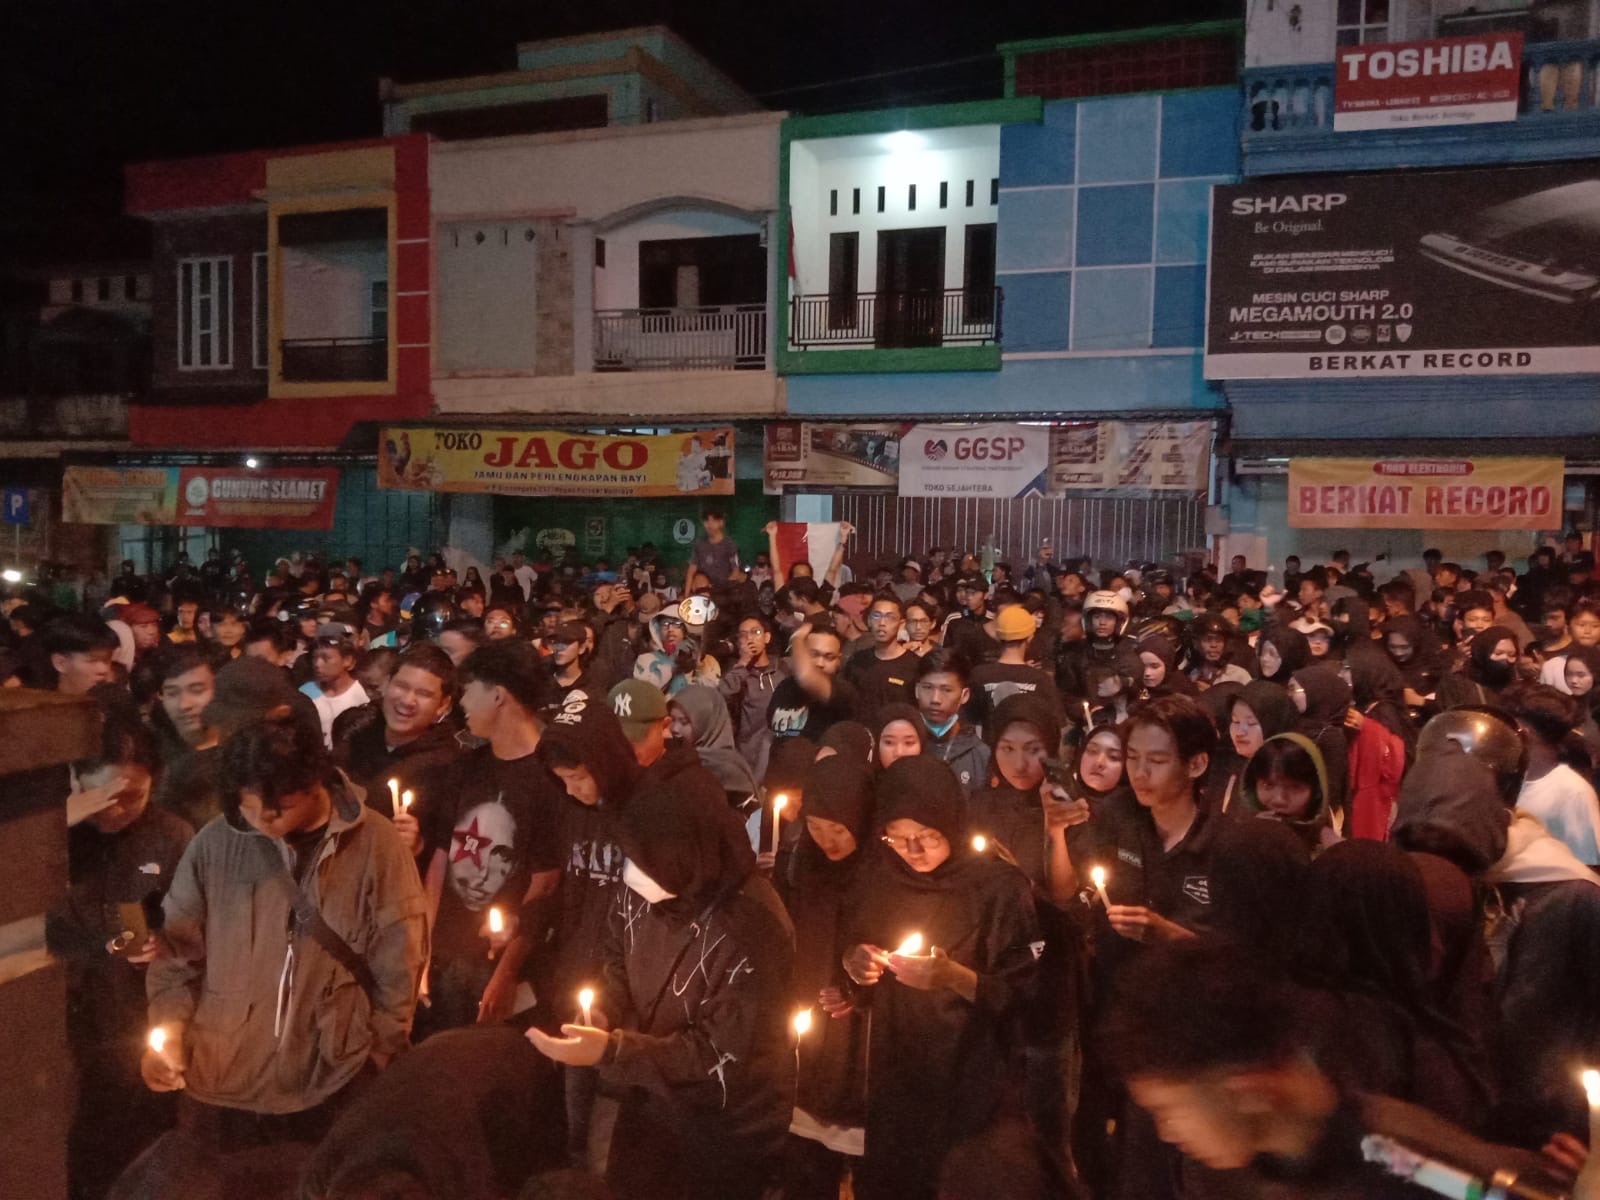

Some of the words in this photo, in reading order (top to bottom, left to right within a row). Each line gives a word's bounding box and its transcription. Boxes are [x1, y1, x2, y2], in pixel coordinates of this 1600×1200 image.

[1342, 41, 1514, 81] TOSHIBA
[1232, 193, 1347, 216] SHARP
[1254, 222, 1270, 234] Be
[1252, 292, 1298, 304] MESIN
[1301, 291, 1336, 303] CUCI
[1340, 290, 1390, 302] SHARP
[1229, 304, 1375, 323] MEGAMOUTH
[1381, 303, 1413, 320] 2.0
[1309, 355, 1411, 371] BERKAT
[1424, 352, 1532, 368] RECORD
[434, 432, 482, 451] TOKO
[484, 437, 649, 470] JAGO
[954, 437, 1025, 461] GGSP
[212, 479, 269, 498] GUNUNG
[271, 480, 327, 500] SLAMET
[924, 484, 944, 492] TOKO
[947, 484, 993, 493] SEJAHTERA
[11, 494, 23, 516] P
[1300, 486, 1413, 515] BERKAT
[1425, 486, 1550, 516] RECORD
[614, 692, 632, 717] NY
